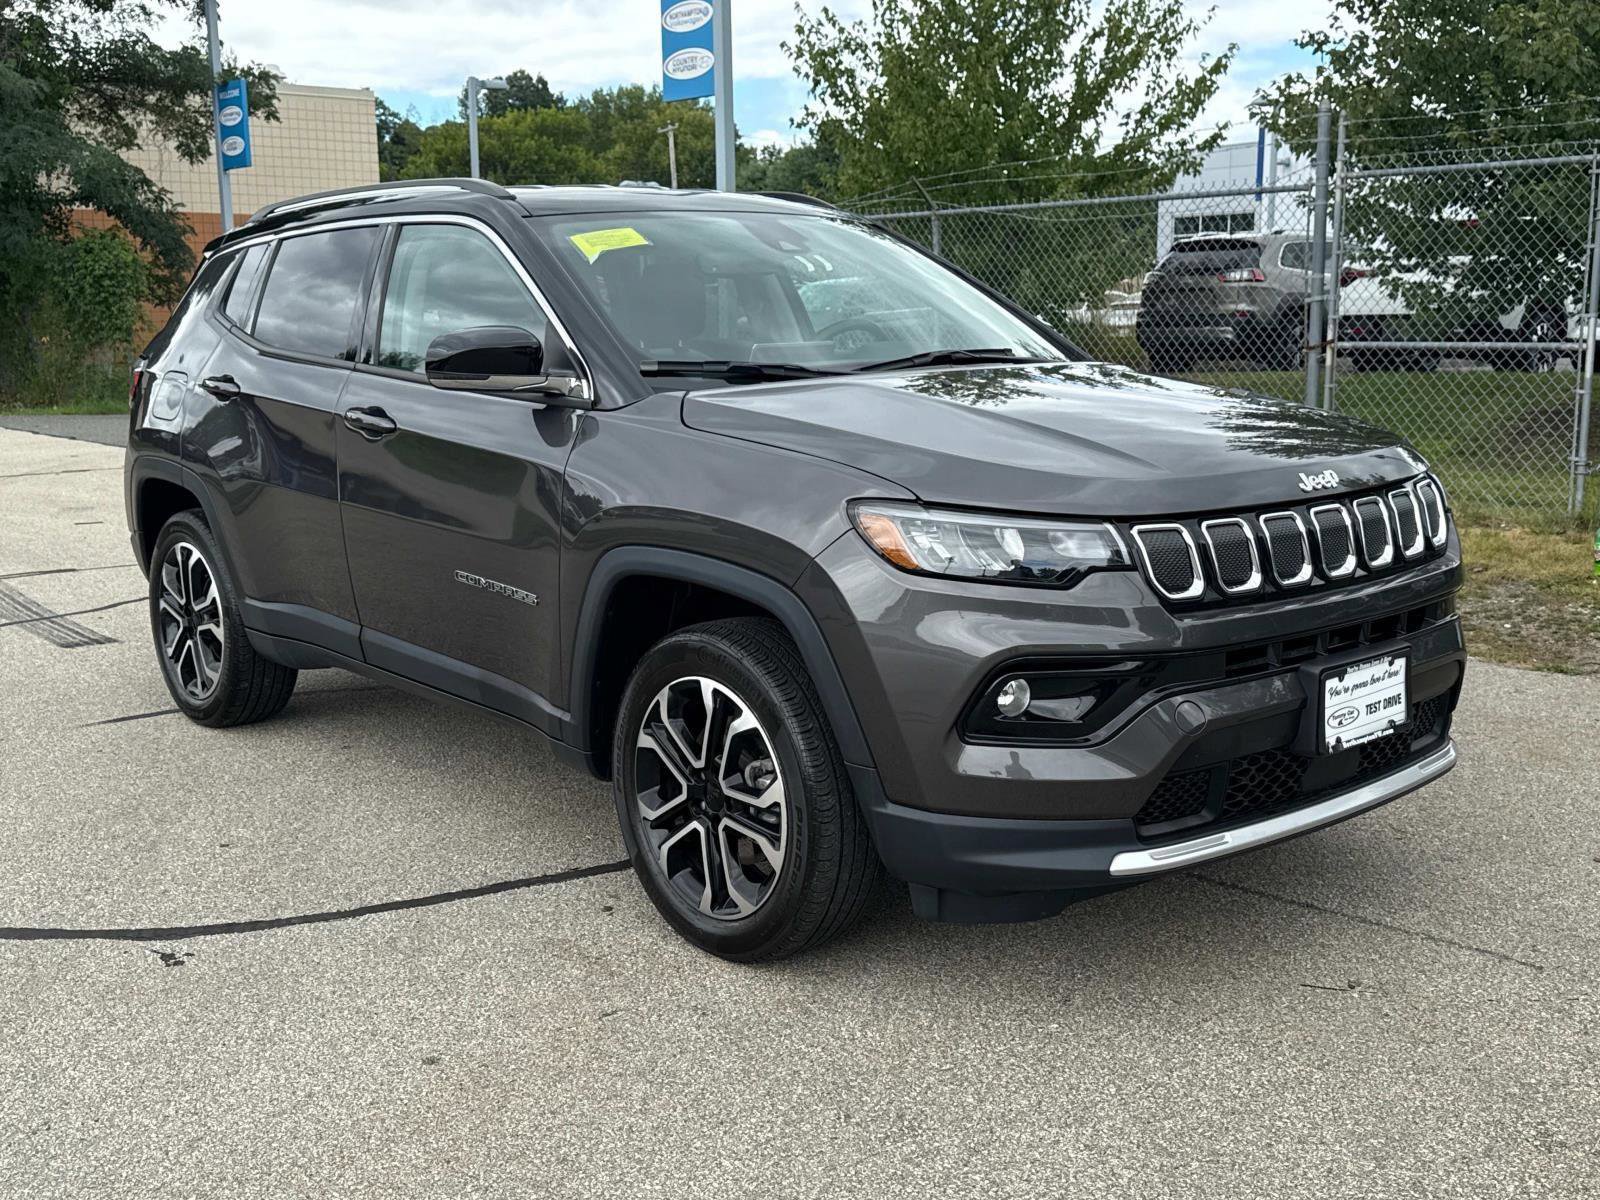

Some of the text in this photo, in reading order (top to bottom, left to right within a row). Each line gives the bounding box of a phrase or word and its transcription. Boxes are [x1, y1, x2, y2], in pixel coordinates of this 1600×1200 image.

[672, 56, 698, 67] COUNTRY
[672, 63, 698, 73] HYUNDAI
[1298, 469, 1339, 491] Jeep
[454, 569, 537, 606] COMPASS
[1328, 685, 1350, 700] You're
[1350, 680, 1369, 696] gonna
[1369, 673, 1381, 686] love
[1365, 693, 1402, 716] TEST DRIVE
